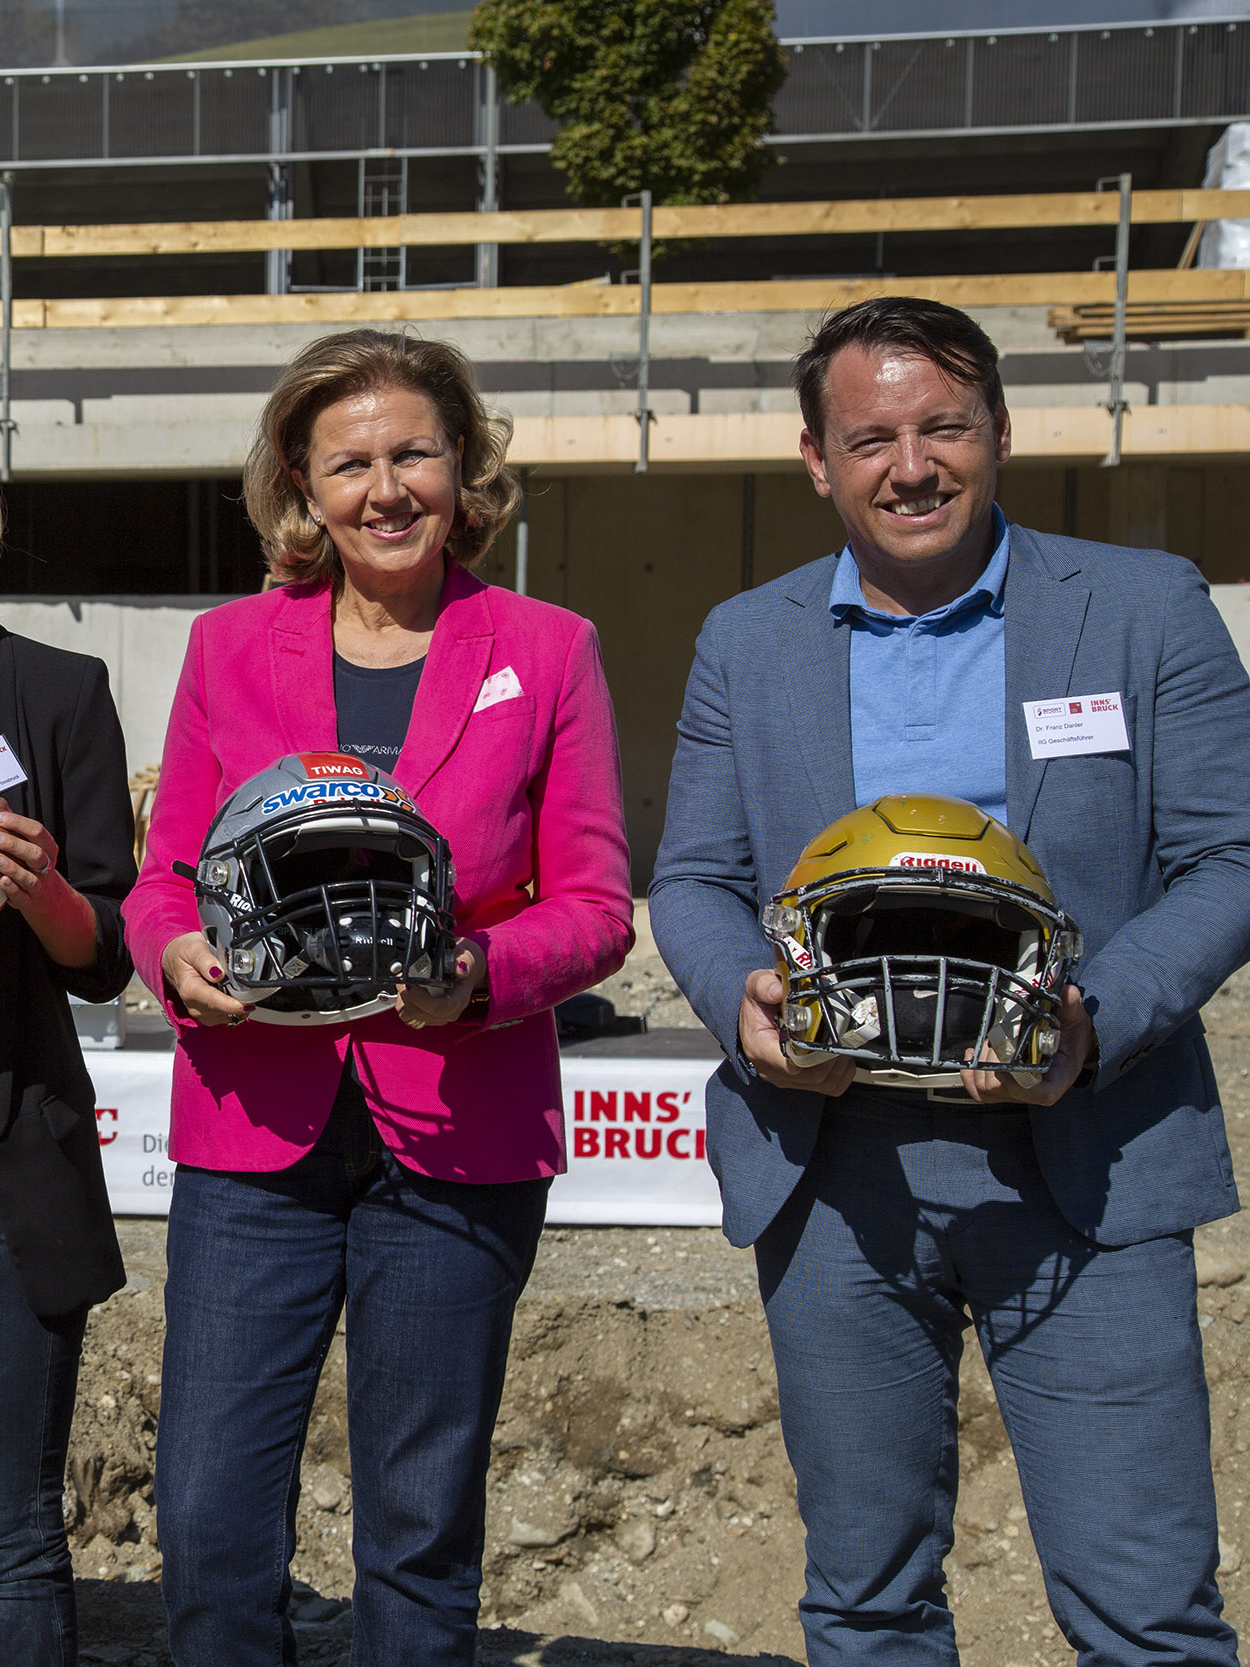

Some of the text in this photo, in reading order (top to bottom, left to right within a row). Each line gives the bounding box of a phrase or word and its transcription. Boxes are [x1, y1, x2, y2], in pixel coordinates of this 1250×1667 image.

[1092, 704, 1119, 713] BRUCK
[1064, 722, 1083, 730] Danler
[1048, 735, 1094, 745] Geschäftsführer
[311, 765, 363, 775] TIWAG
[263, 782, 381, 814] swarco
